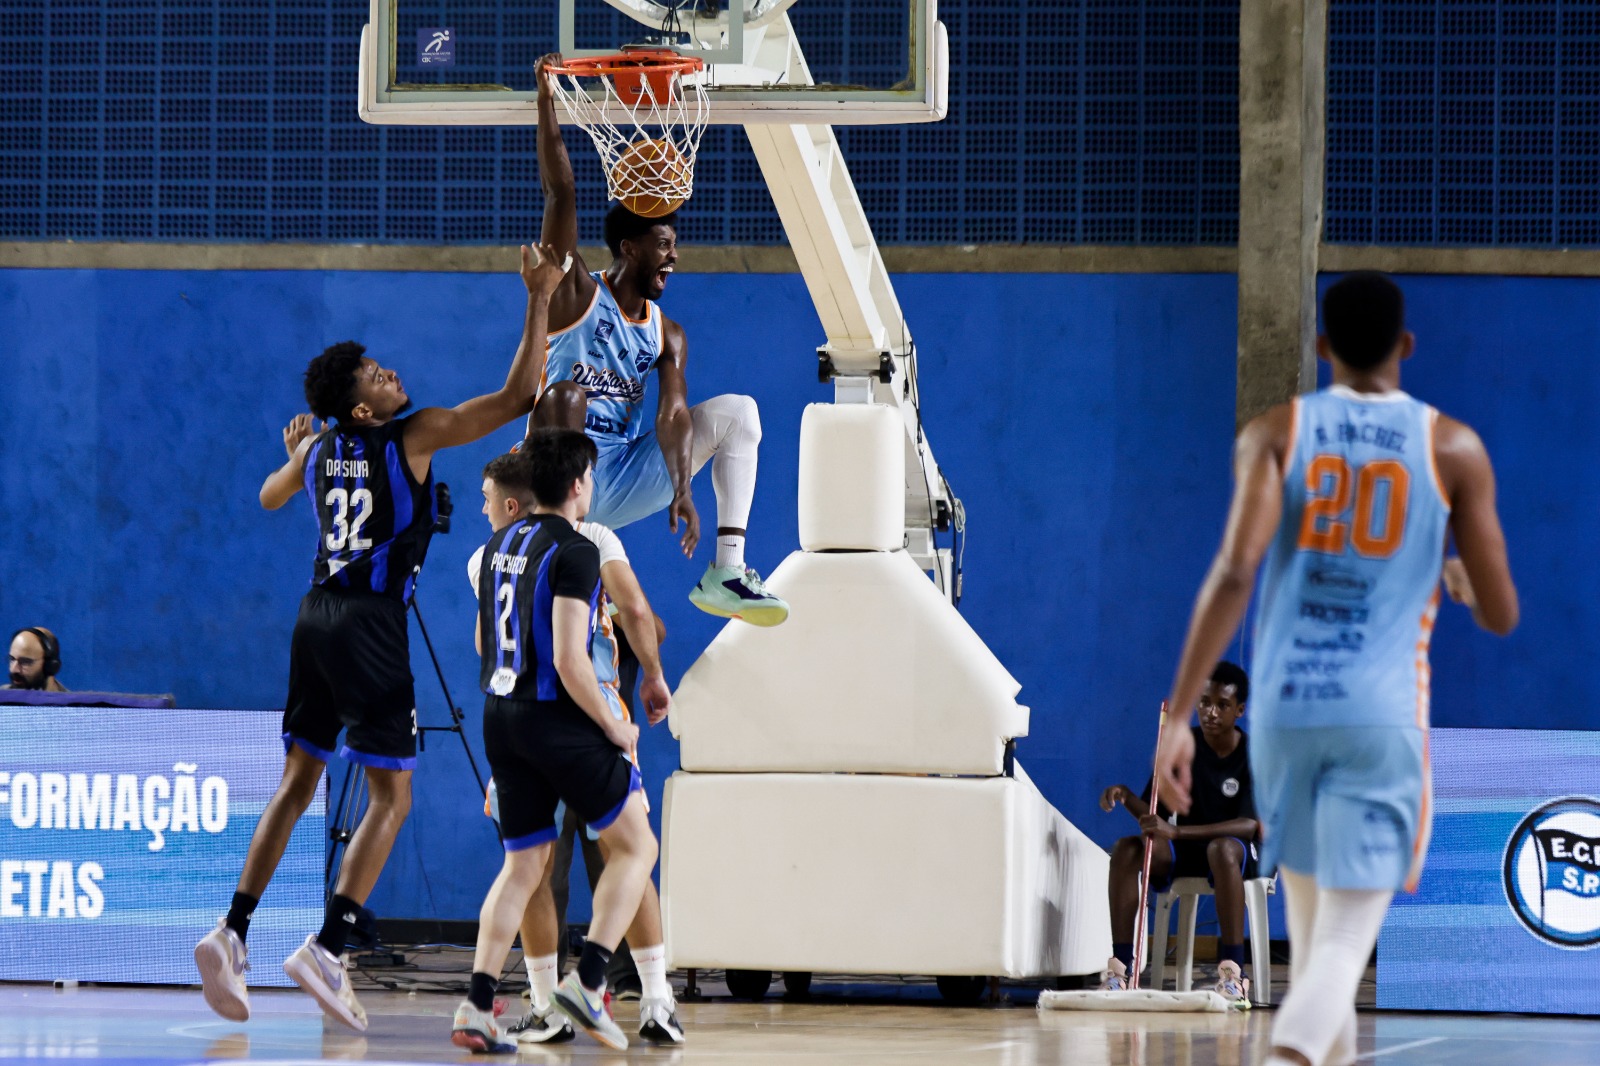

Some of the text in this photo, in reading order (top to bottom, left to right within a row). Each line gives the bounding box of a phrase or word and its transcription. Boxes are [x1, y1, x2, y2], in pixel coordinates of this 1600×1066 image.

[326, 488, 373, 551] 32
[1298, 454, 1410, 559] 20
[491, 552, 528, 576] PACHECO
[498, 582, 517, 651] 2
[1, 860, 104, 918] ETAS
